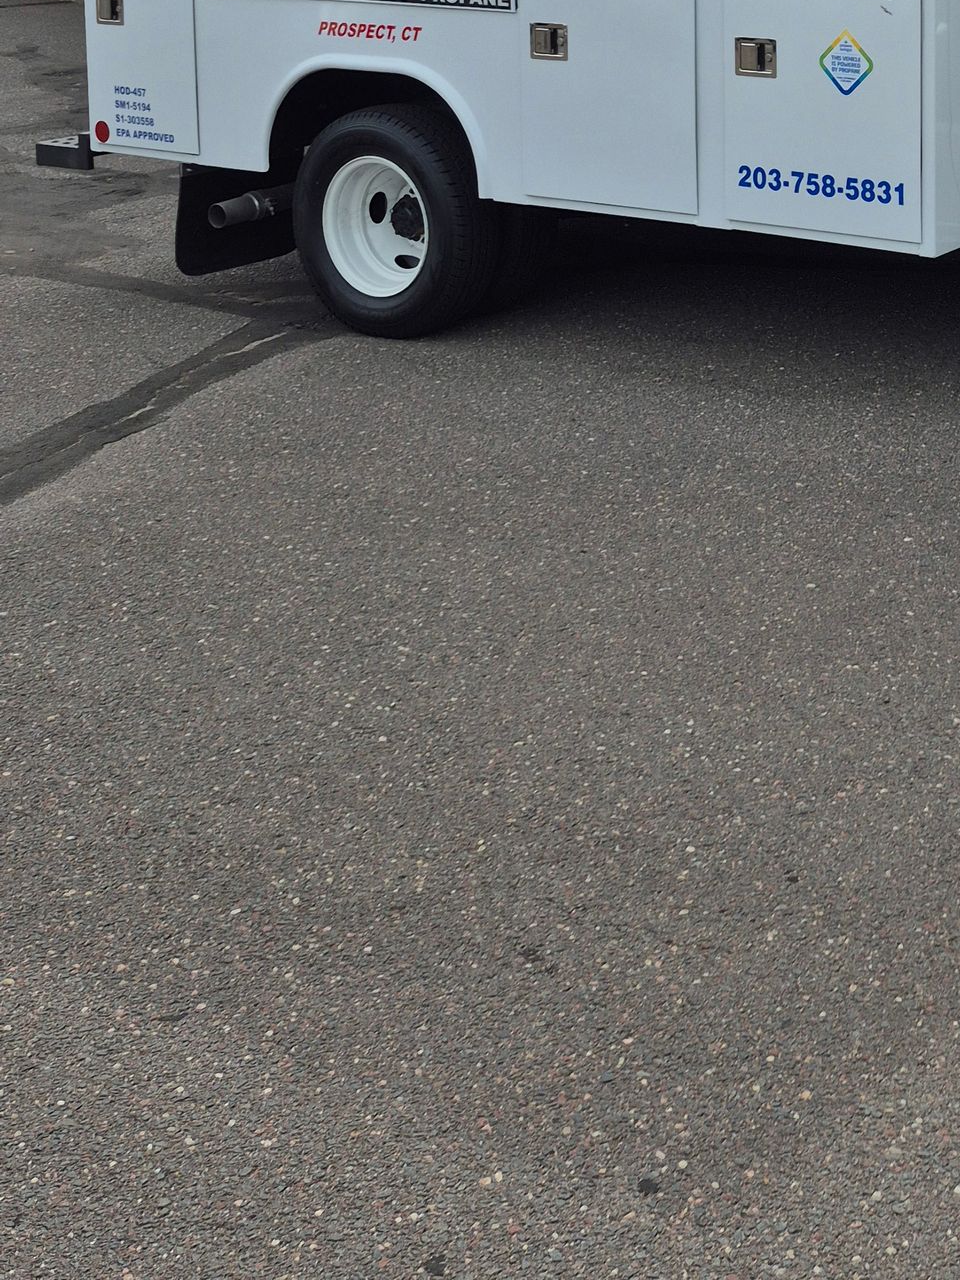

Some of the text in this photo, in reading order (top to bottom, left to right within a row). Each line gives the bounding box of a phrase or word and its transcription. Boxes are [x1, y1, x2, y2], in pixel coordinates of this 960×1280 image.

[318, 21, 422, 43] PROSPECT, CT
[114, 85, 146, 97] HOD-457
[115, 100, 151, 112] SM1-5194
[116, 128, 175, 143] EPA APPROVED
[738, 165, 905, 206] 203-758-5831
